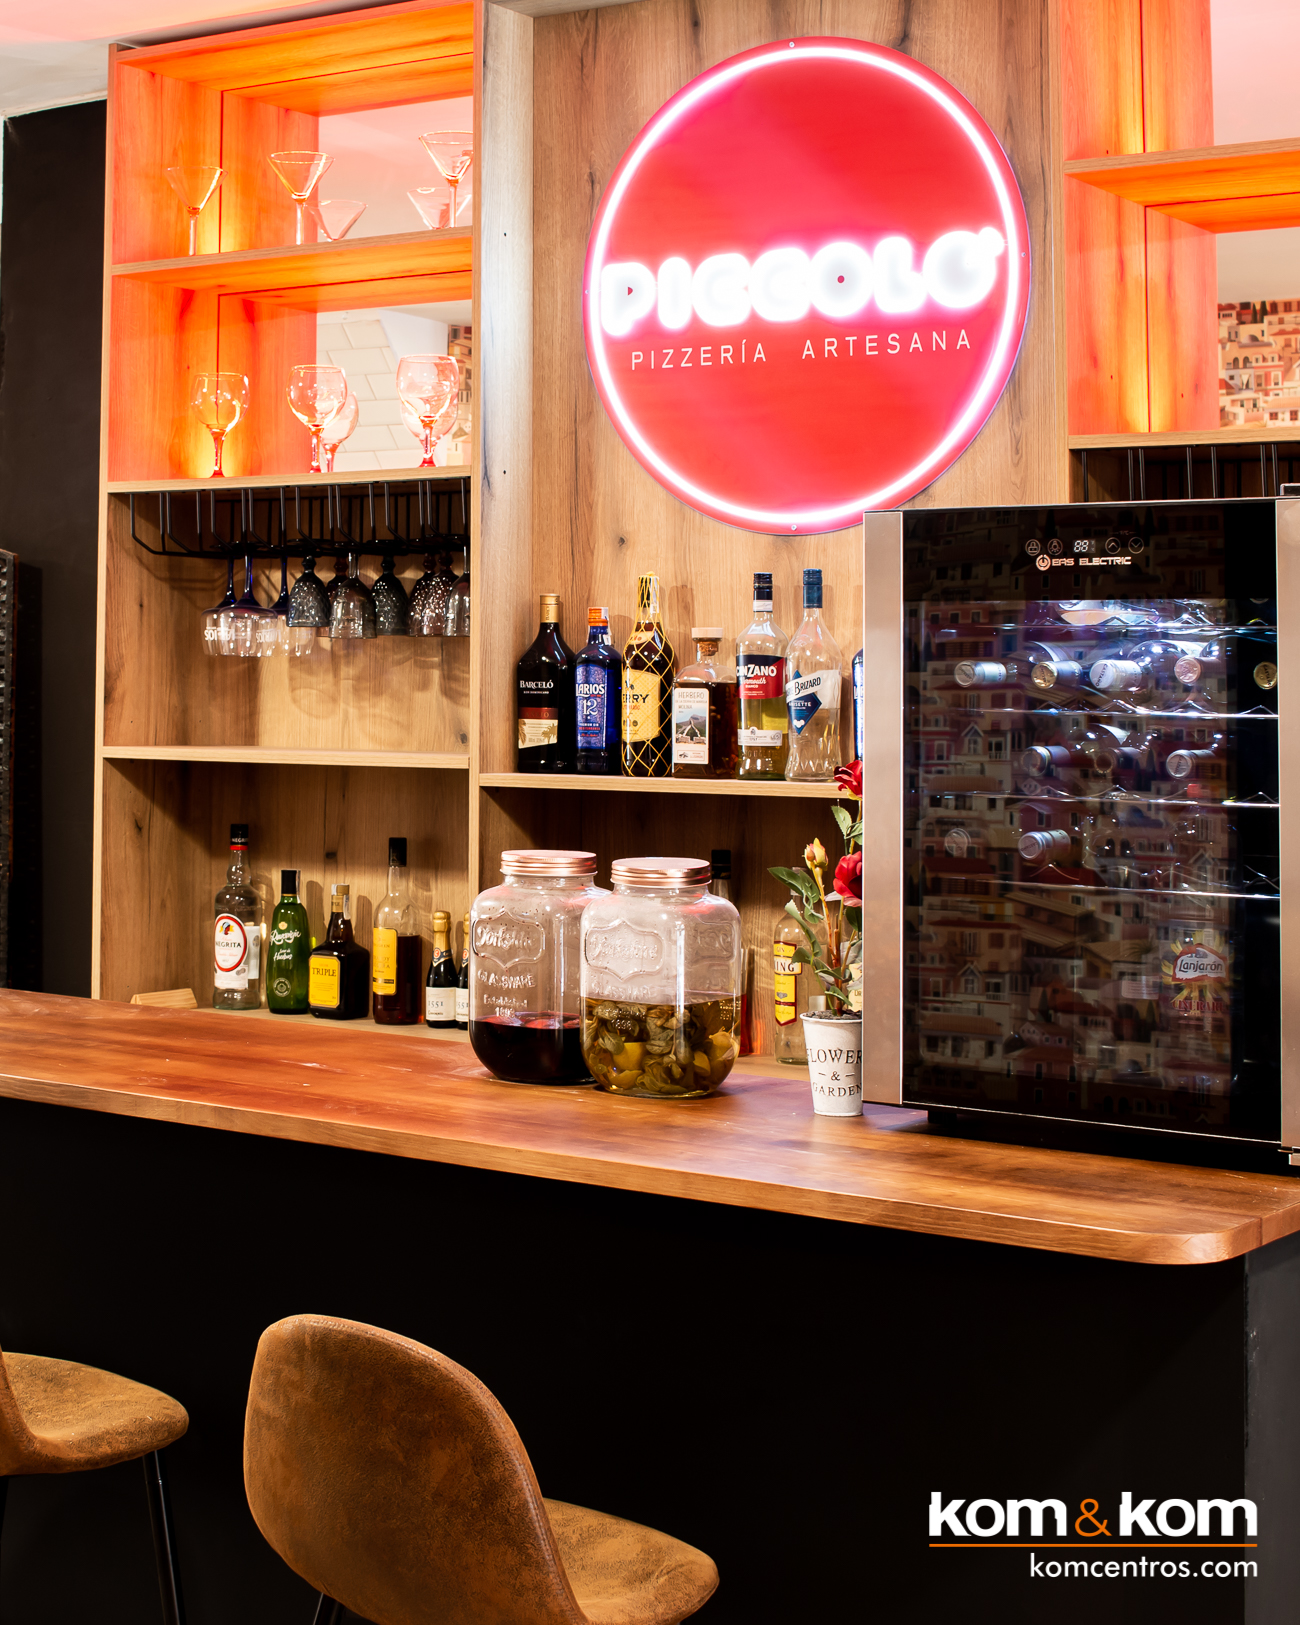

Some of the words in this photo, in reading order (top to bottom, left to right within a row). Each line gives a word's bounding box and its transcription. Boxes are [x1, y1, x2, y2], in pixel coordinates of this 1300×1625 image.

[631, 339, 767, 371] PIZZERÍA
[801, 328, 971, 360] ARTESANA
[1051, 557, 1075, 566] EAS
[1078, 556, 1132, 566] ELECTRIC
[519, 679, 555, 690] BARCELÓ
[575, 683, 606, 698] LARIOS
[794, 676, 822, 696] BRIZARD
[622, 693, 650, 704] ERRY
[678, 691, 705, 700] HERBERO
[580, 699, 599, 716] 12
[774, 960, 795, 973] ING
[1178, 958, 1223, 973] Lanjarón
[311, 967, 337, 977] TRIPLE
[457, 1001, 469, 1010] 551
[830, 1070, 841, 1081] &
[812, 1081, 862, 1098] GARDEN
